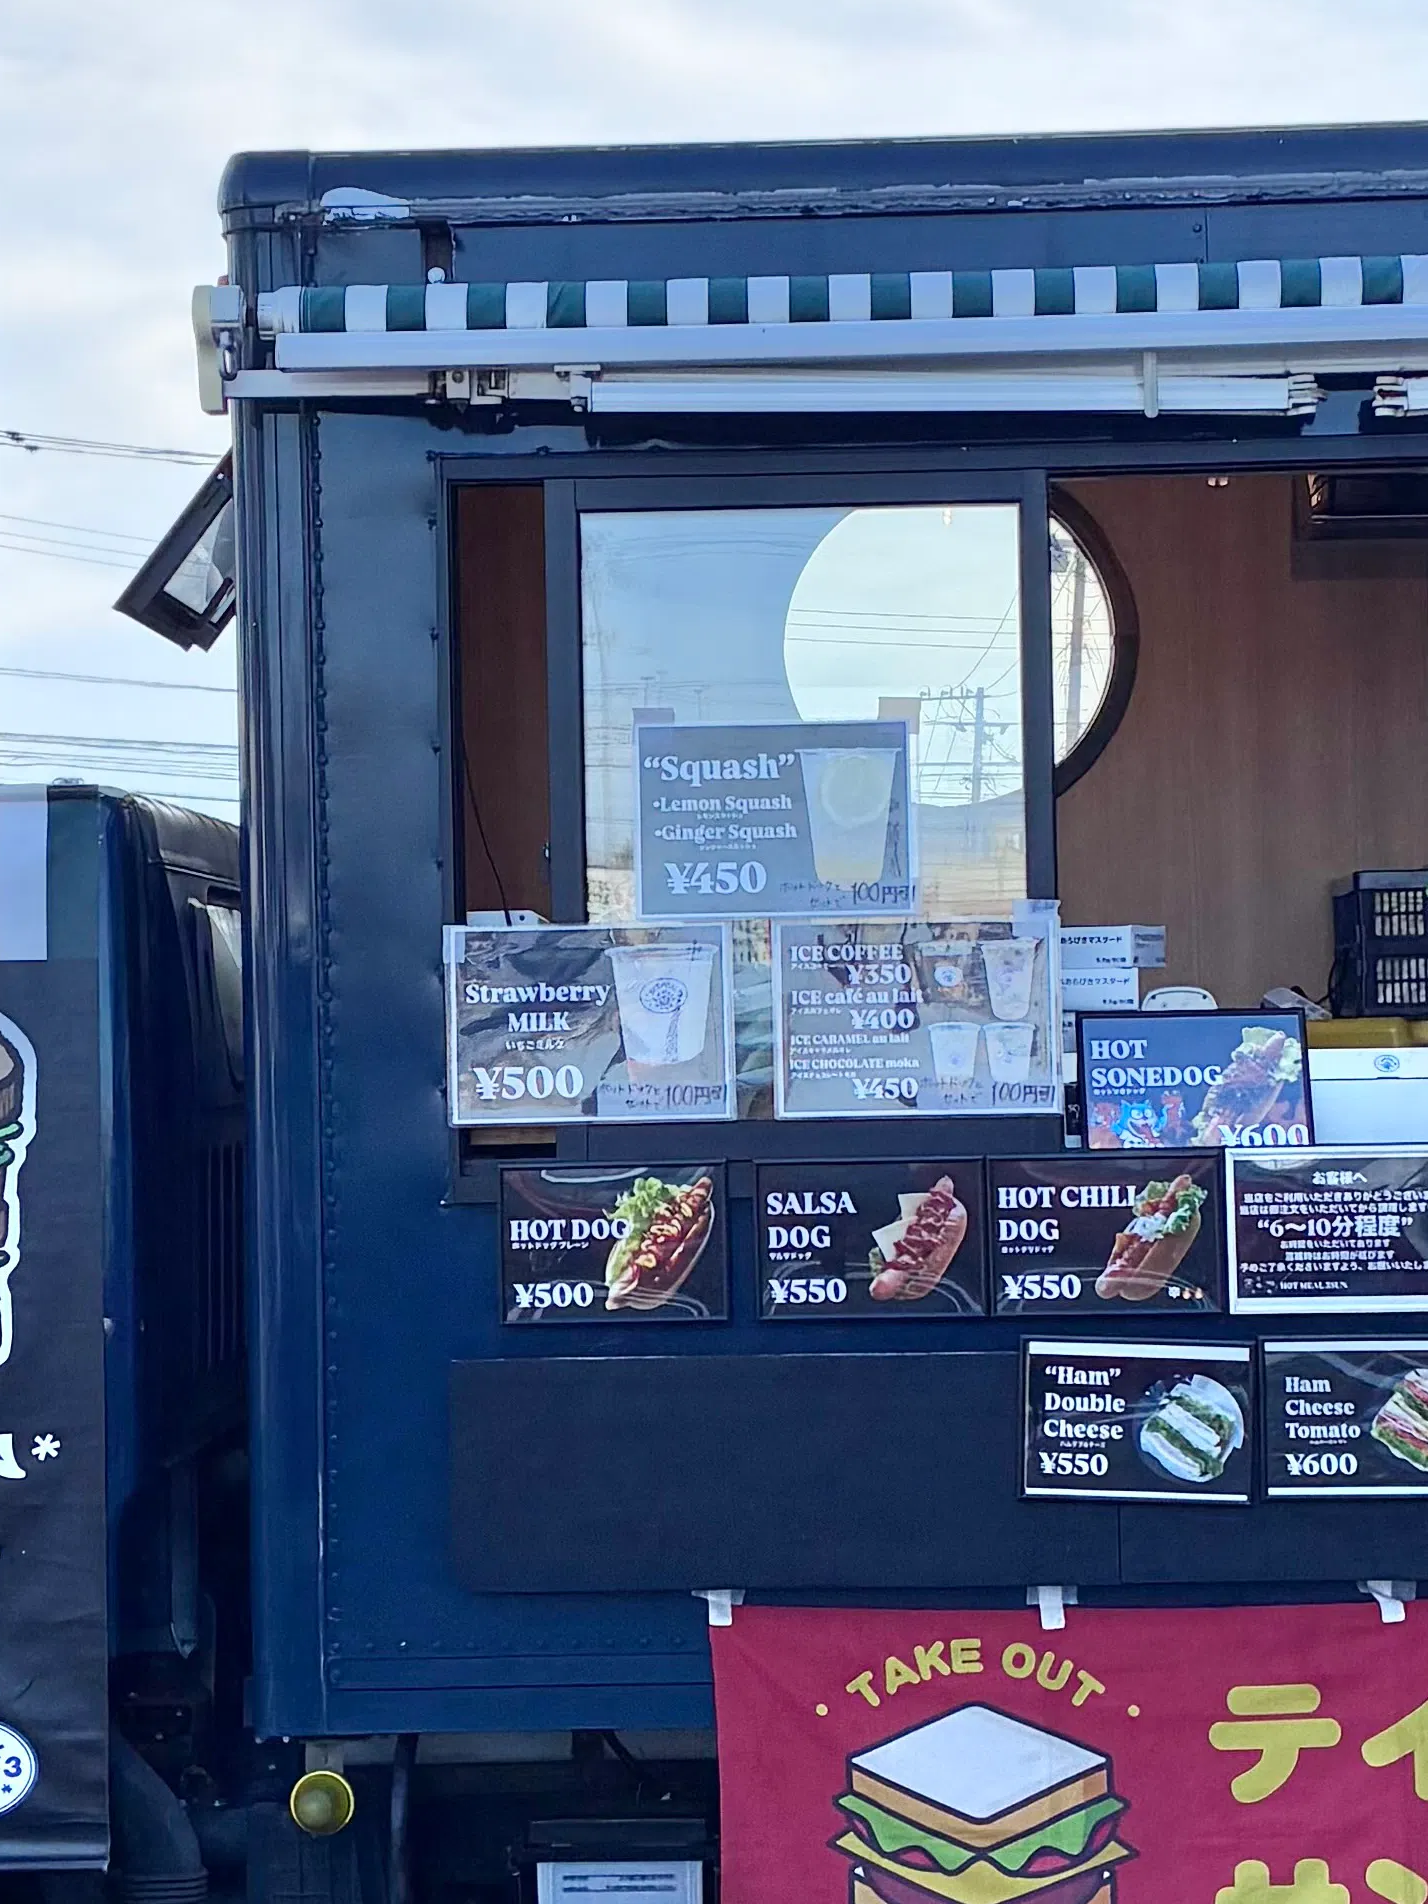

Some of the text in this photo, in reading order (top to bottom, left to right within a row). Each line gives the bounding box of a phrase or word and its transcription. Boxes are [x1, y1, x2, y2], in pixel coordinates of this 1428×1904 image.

[643, 753, 796, 787] “Squash”
[724, 794, 792, 814] Squash
[728, 823, 798, 844] Squash
[663, 860, 767, 895] ¥450
[790, 943, 904, 962] ICE COFFEE
[846, 963, 912, 985] ¥350
[465, 981, 612, 1007] Strawberry
[791, 989, 822, 1005] ICE
[865, 991, 890, 1005] au
[508, 1011, 572, 1033] MILK
[849, 1008, 915, 1030] ¥400
[790, 1034, 812, 1046] ICE
[812, 1033, 871, 1046] CARAMEL
[1090, 1039, 1148, 1061] HOT
[789, 1057, 920, 1070] ICE CHOCOLATE moka
[470, 1063, 584, 1101] ¥500
[1091, 1065, 1222, 1088] SONEDOG
[852, 1077, 919, 1100] ¥450
[1218, 1123, 1310, 1147] ¥600
[766, 1191, 857, 1215] SALSA
[998, 1185, 1137, 1209] HOT CHILI
[509, 1218, 633, 1241] HOT DOG
[767, 1226, 831, 1249] DOG
[998, 1218, 1060, 1242] DOG
[512, 1282, 595, 1309] ¥500
[768, 1278, 847, 1304] ¥550
[1001, 1274, 1082, 1300] ¥550
[1044, 1365, 1121, 1386] “Ham”
[1284, 1376, 1332, 1393] Ham
[1044, 1392, 1126, 1413] Double
[1284, 1399, 1356, 1416] Cheese
[1043, 1419, 1124, 1440] Cheese
[1284, 1422, 1361, 1439] Tomato
[1038, 1451, 1109, 1476] ¥550
[1284, 1453, 1358, 1476] ¥600
[846, 1637, 1106, 1707] TAKE OUT
[3, 1756, 23, 1778] 3
